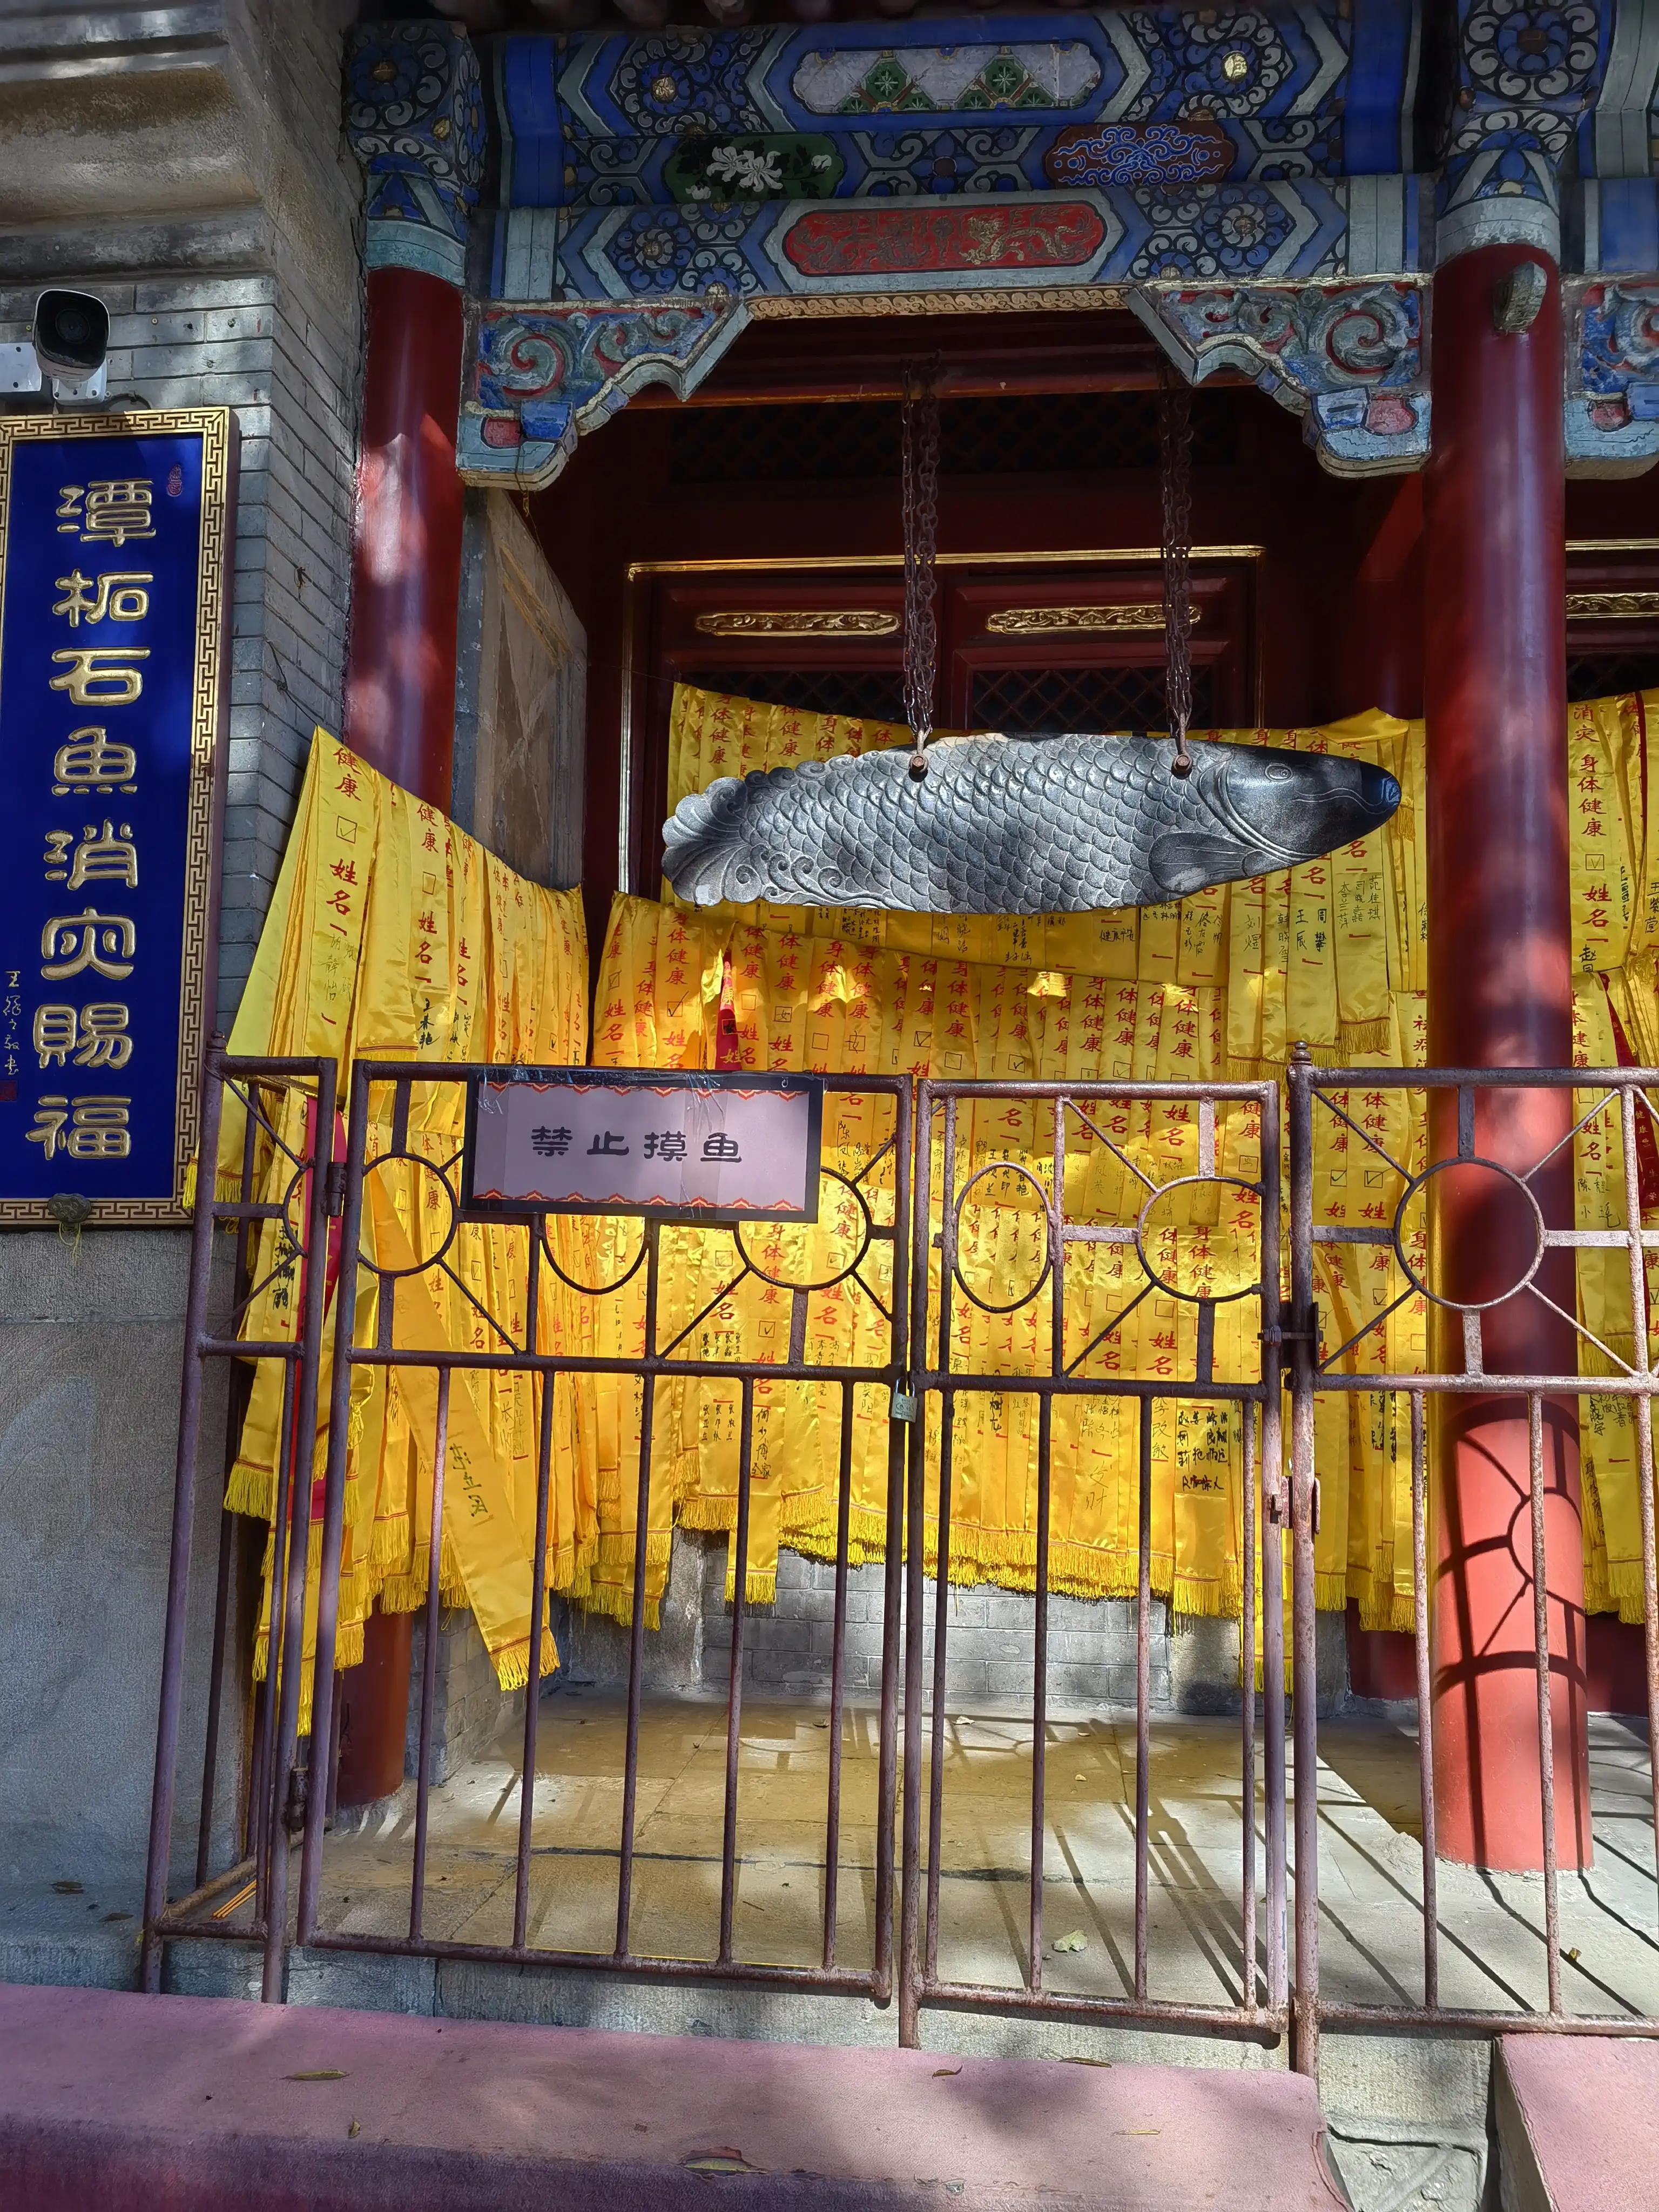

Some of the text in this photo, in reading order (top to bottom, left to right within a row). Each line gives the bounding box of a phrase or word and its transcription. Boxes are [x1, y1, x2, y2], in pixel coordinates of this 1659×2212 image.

[1576, 753, 1607, 838] 身体健康
[813, 940, 845, 1019] 身体健康
[531, 1125, 742, 1163] 禁止摸鱼
[1158, 1104, 1192, 1147] 姓名
